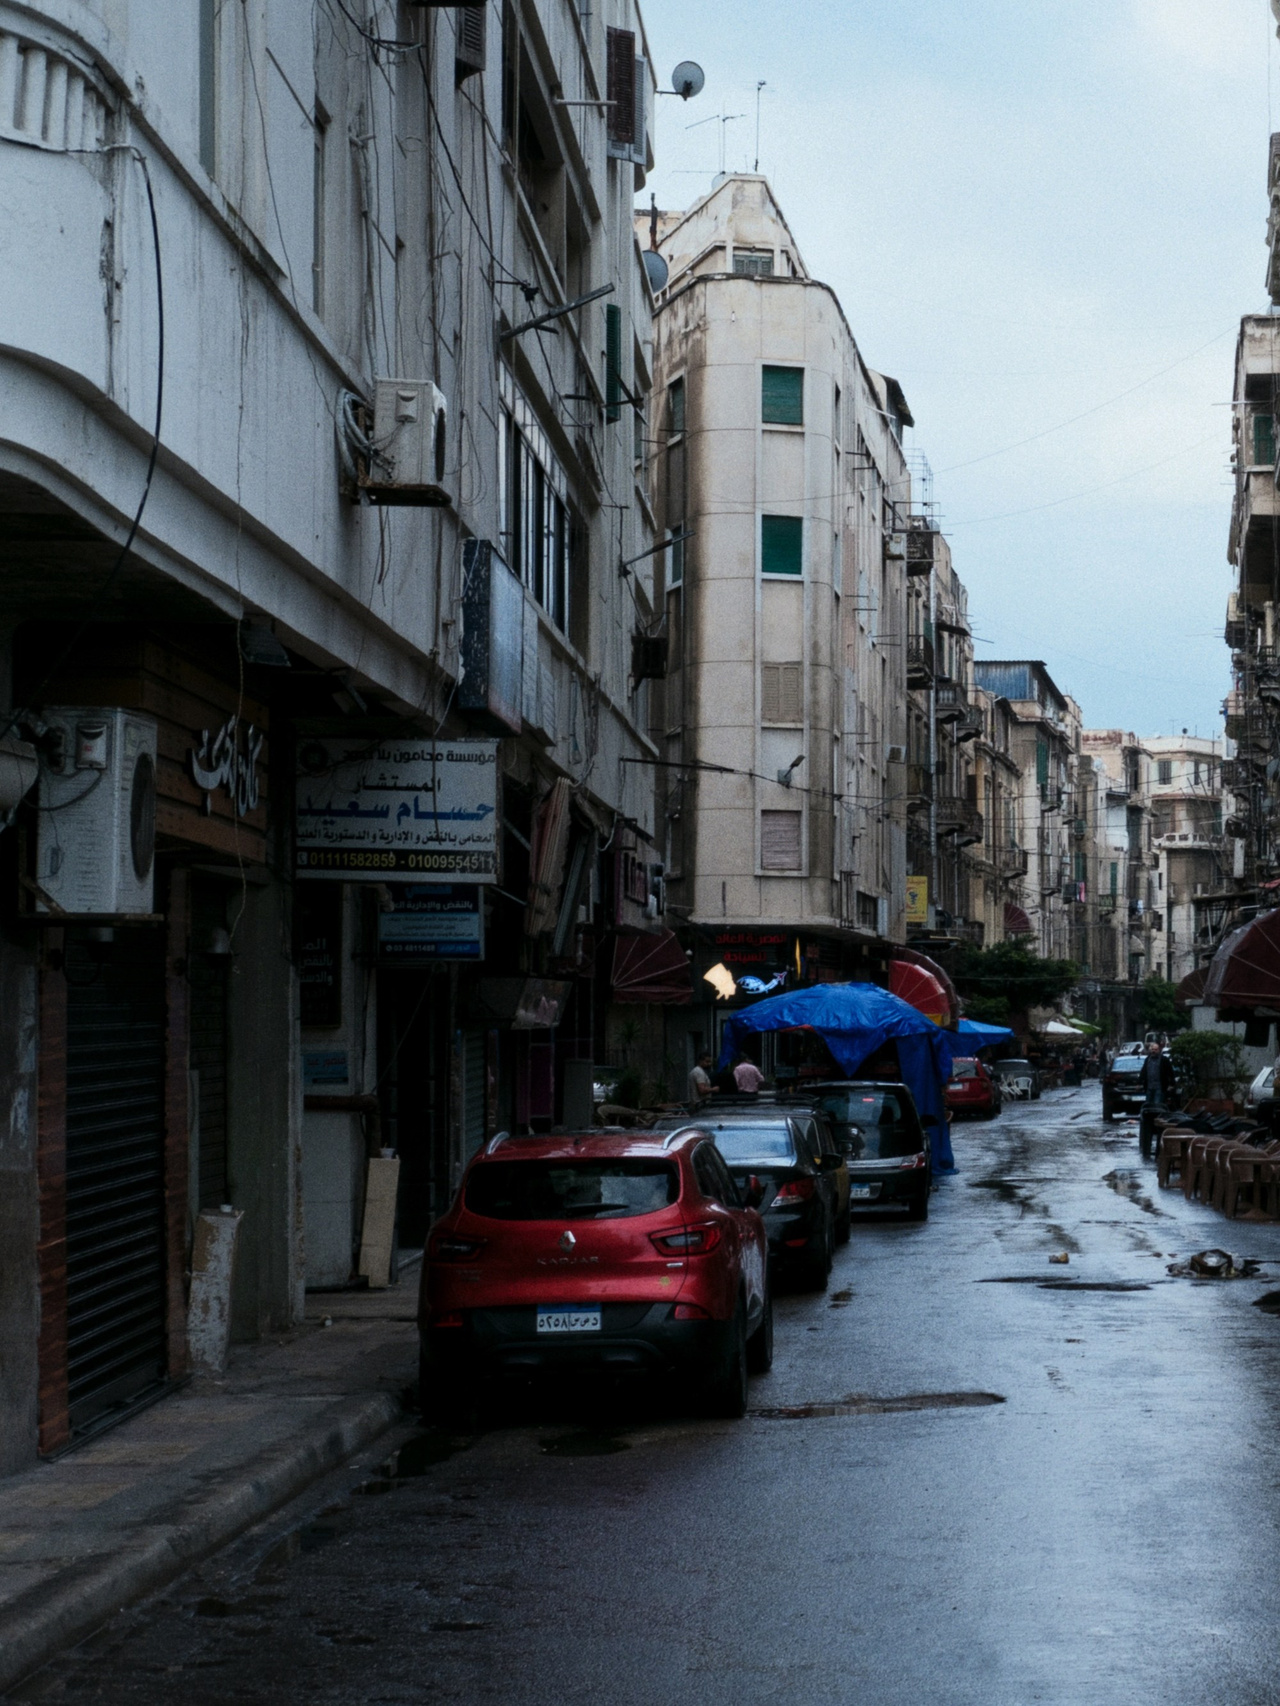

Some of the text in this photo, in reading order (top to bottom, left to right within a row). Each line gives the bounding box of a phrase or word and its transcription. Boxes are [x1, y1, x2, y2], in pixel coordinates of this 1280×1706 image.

[353, 773, 440, 793] المستشار
[297, 795, 494, 826] حسام سعيد
[309, 852, 396, 868] 01111582859
[407, 853, 493, 870] 01009554511
[536, 1256, 600, 1266] KADJAR
